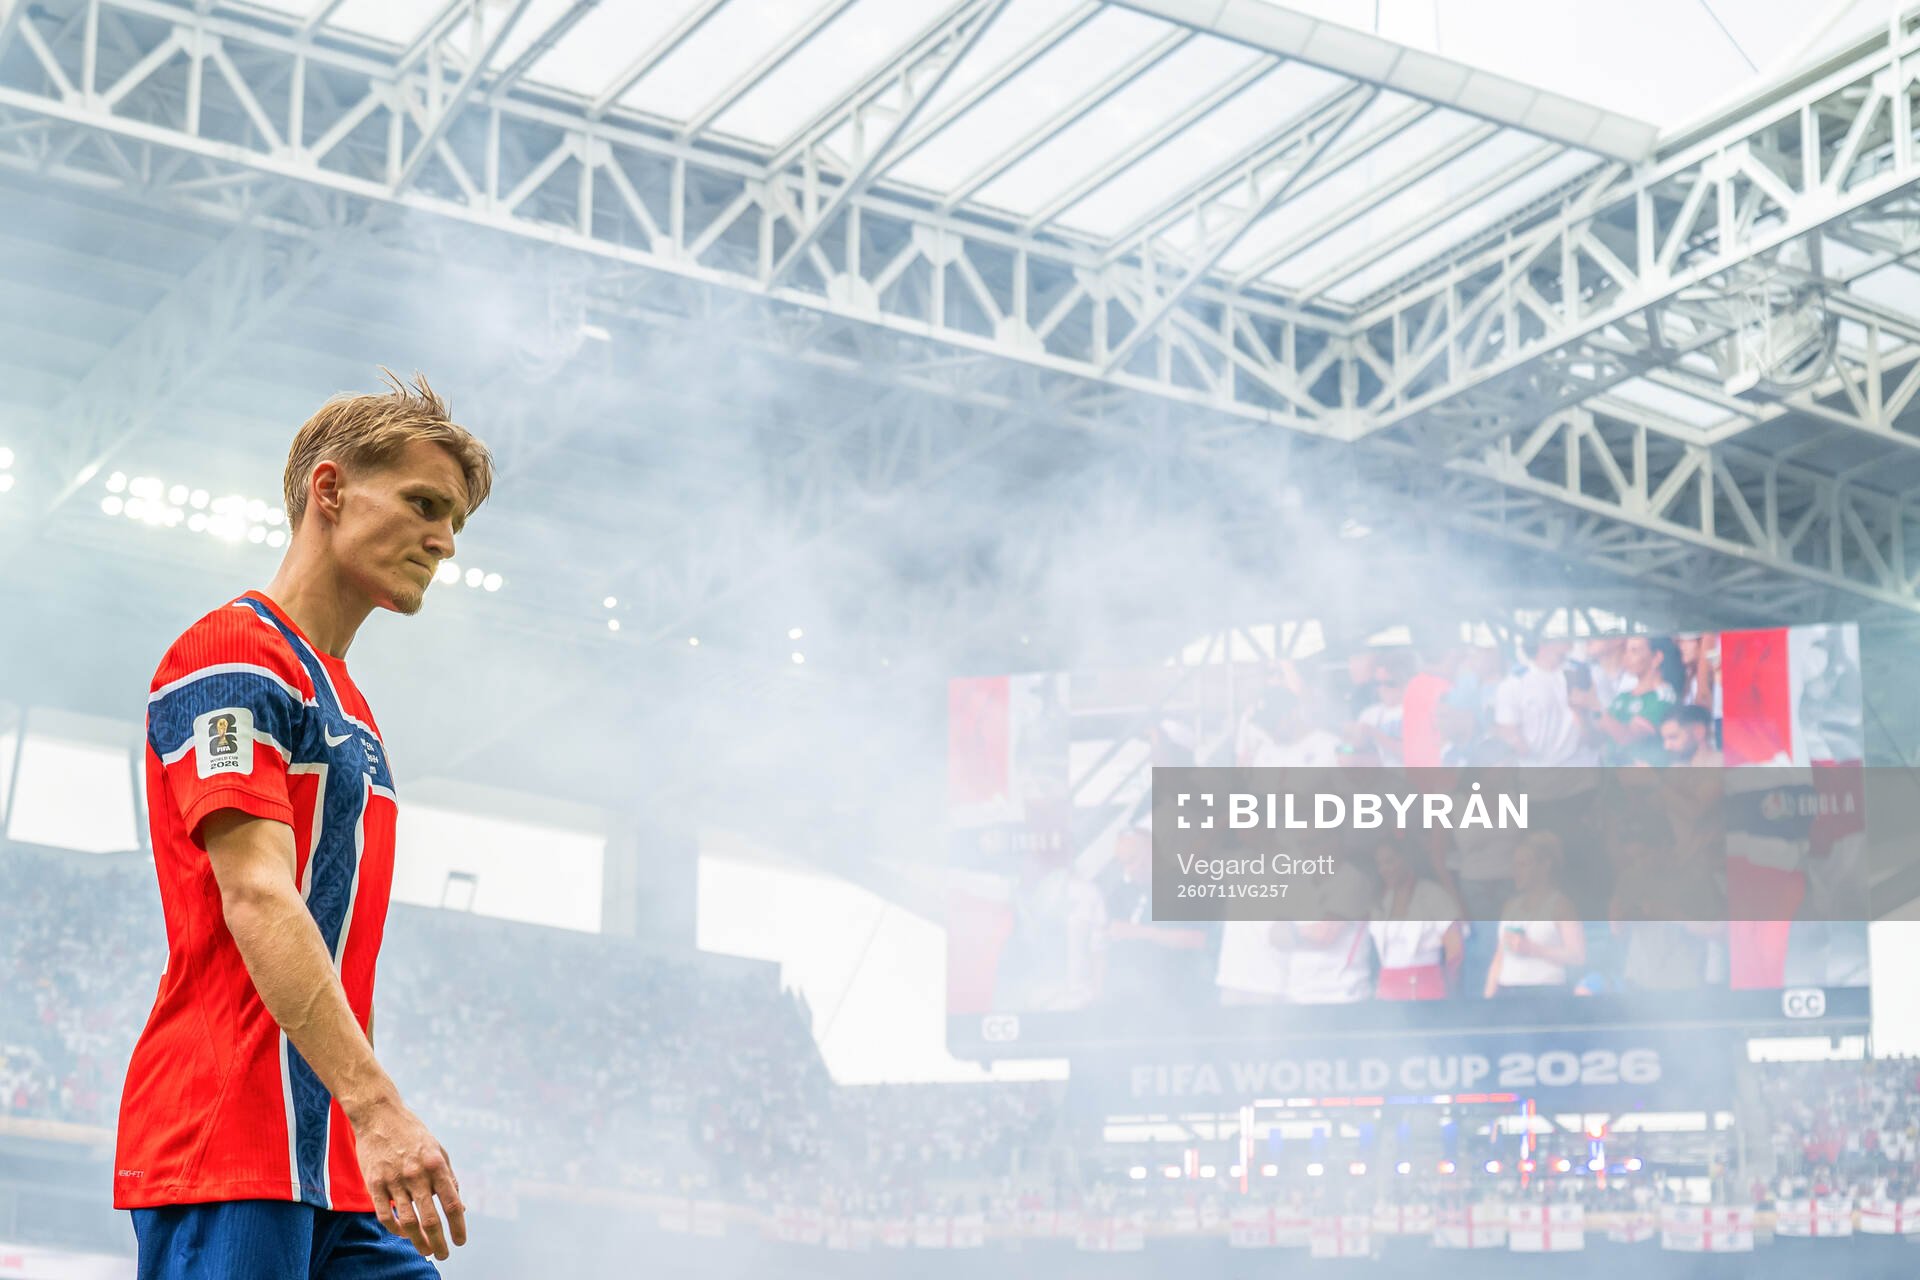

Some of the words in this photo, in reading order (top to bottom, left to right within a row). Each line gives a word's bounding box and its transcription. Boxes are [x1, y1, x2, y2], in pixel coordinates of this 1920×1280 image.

[216, 745, 230, 753] FIFA
[210, 760, 239, 770] 2026
[1130, 1063, 1223, 1096] FIFA
[1230, 1058, 1391, 1093] WORLD
[1400, 1055, 1490, 1090] CUP
[1499, 1049, 1662, 1086] 2026
